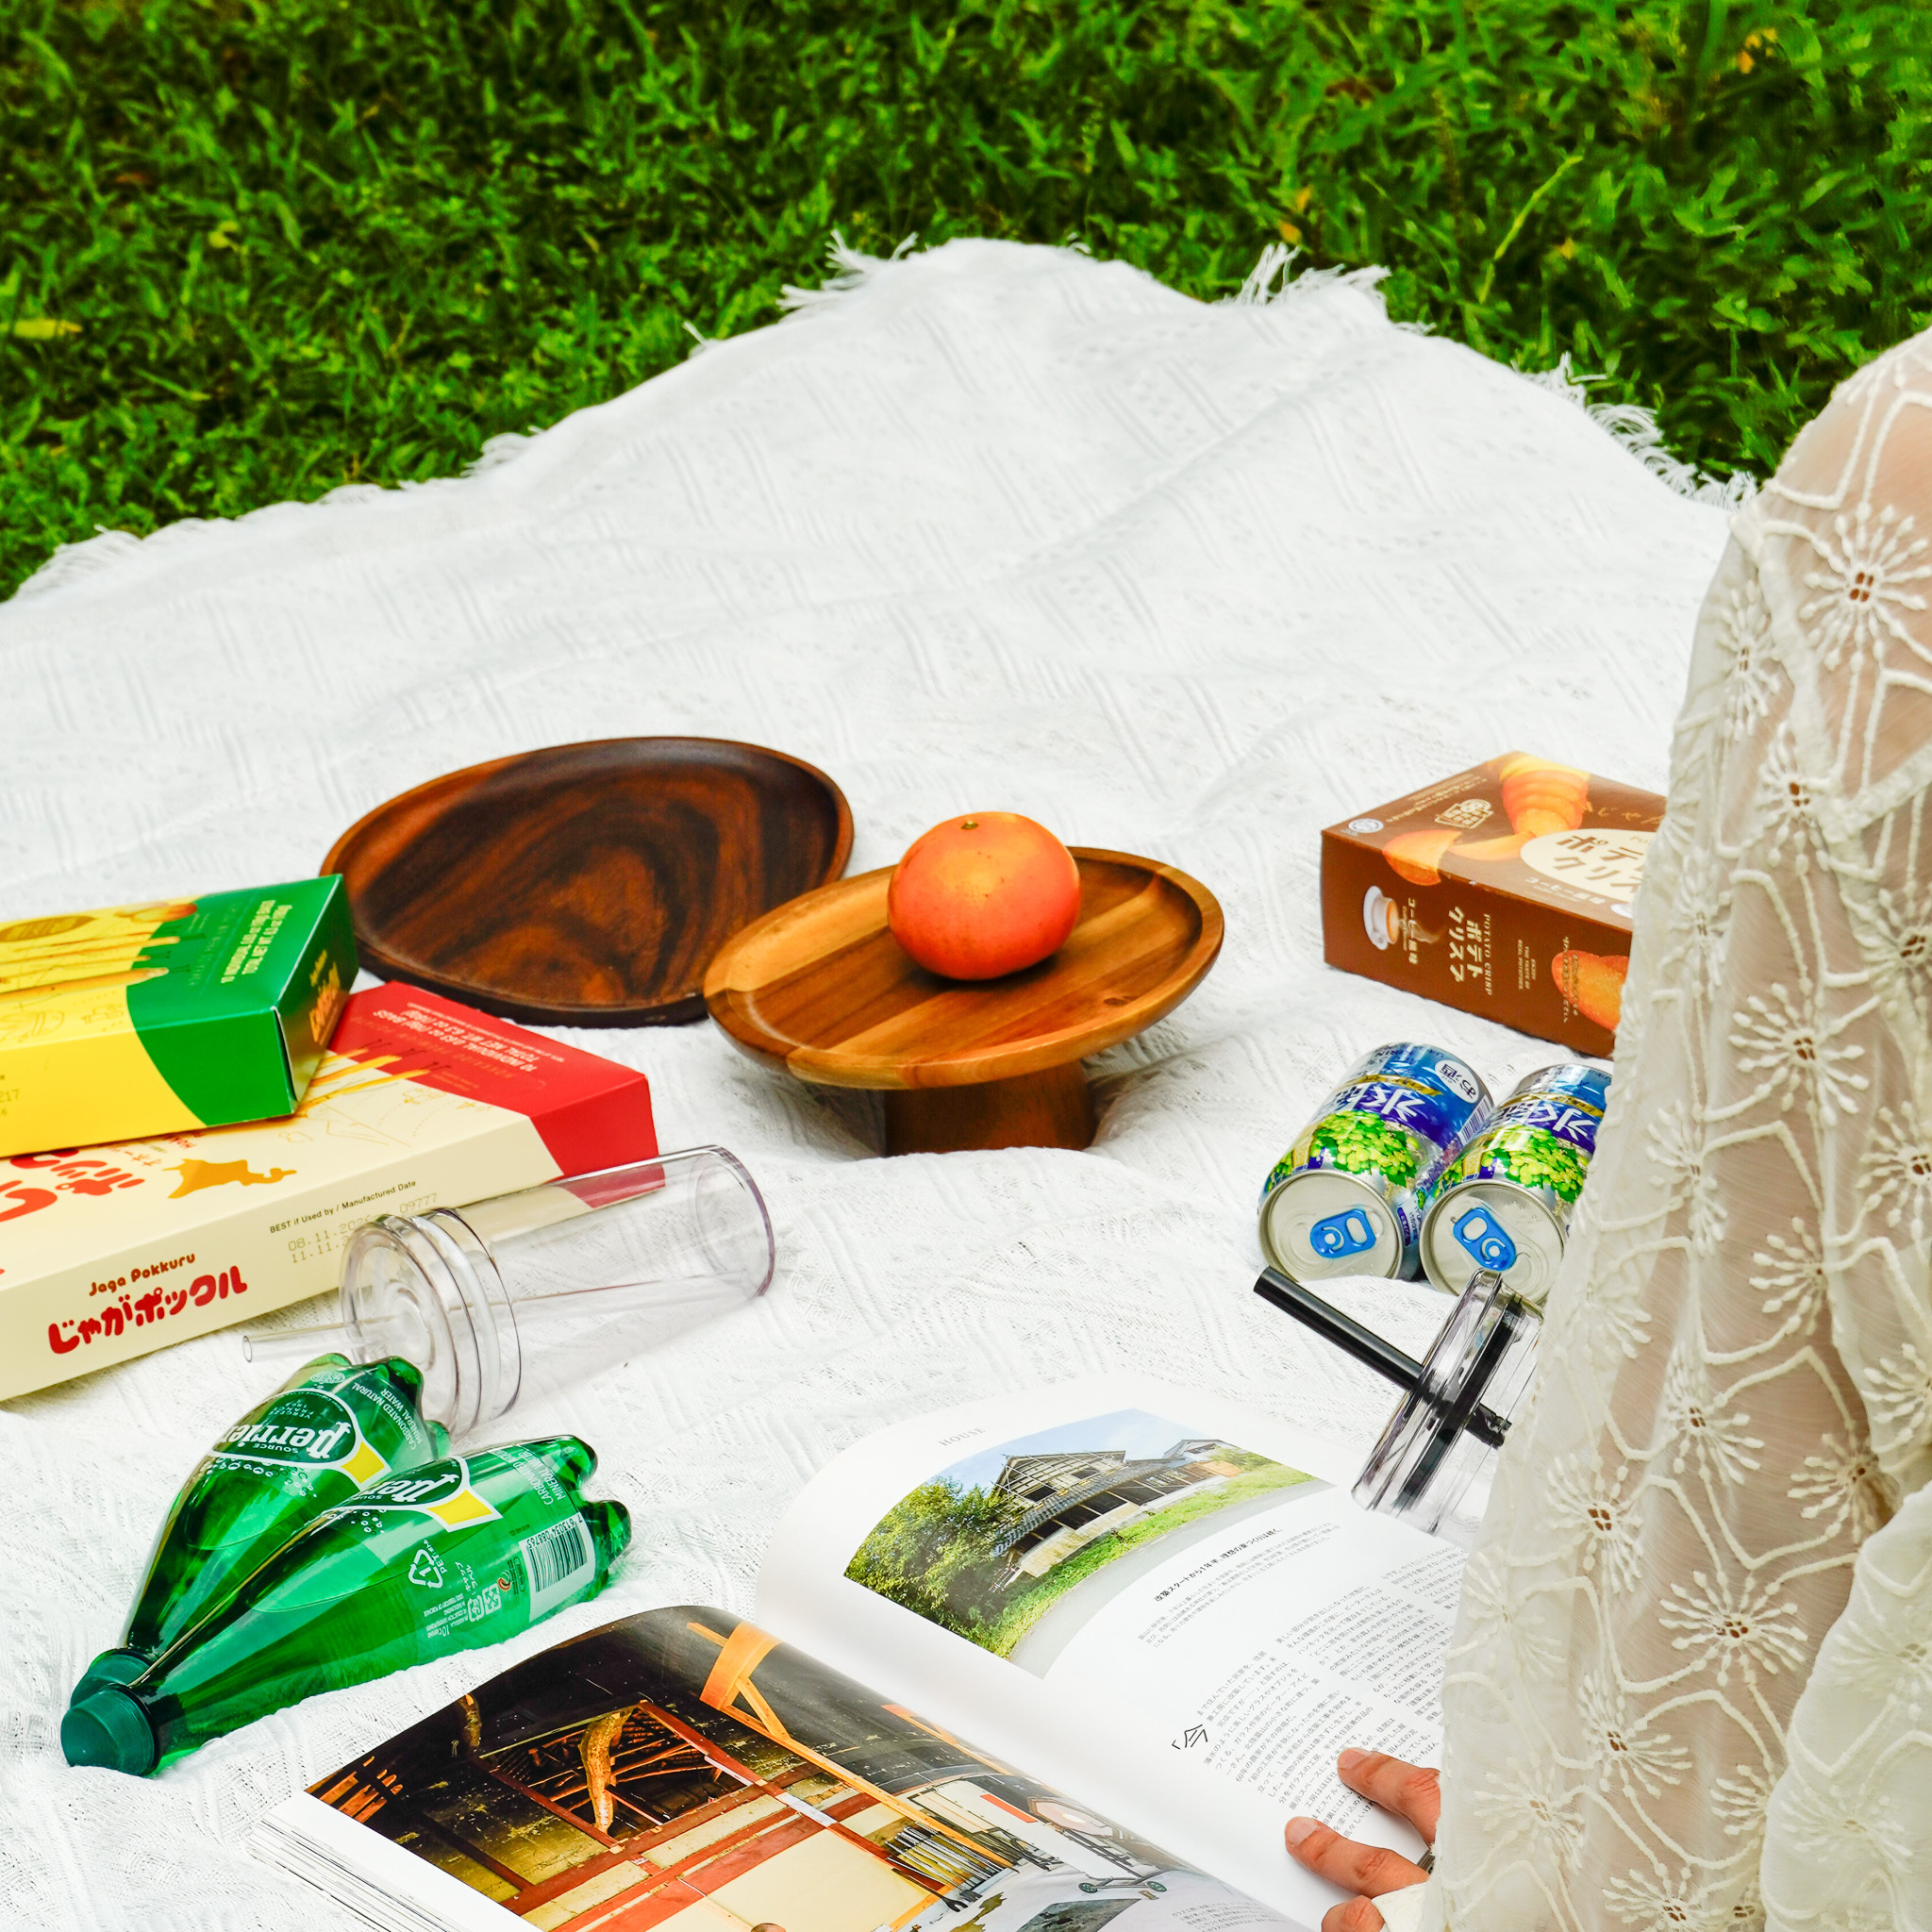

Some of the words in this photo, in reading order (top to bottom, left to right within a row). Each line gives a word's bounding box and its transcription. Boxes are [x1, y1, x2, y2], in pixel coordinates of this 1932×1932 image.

[1449, 907, 1464, 982] クリスプ
[1467, 920, 1483, 978] ポテト
[1441, 1062, 1479, 1100] お酒
[269, 1221, 291, 1234] BEST
[293, 1215, 300, 1225] if
[301, 1208, 323, 1223] Used
[324, 1208, 334, 1217] by
[341, 1187, 396, 1209] Manufactured
[397, 1180, 416, 1191] Date
[89, 1276, 126, 1296] Jaga
[130, 1253, 196, 1283] Pokkuru
[48, 1265, 248, 1355] じゃがポックル
[350, 1381, 385, 1406] NATURAL
[380, 1388, 404, 1410] WATER
[381, 1402, 418, 1450] CARBONATED
[400, 1408, 423, 1444] MINERAL
[939, 1427, 987, 1446] HOUSE
[252, 1443, 298, 1454] SOURCE
[518, 1450, 542, 1469] WATER
[512, 1460, 553, 1505] CARBONATED
[539, 1467, 565, 1500] MINERAL
[551, 1517, 575, 1537] 613034
[577, 1514, 582, 1523] 7
[525, 1529, 551, 1549] 088765
[1172, 1724, 1208, 1749] 「今
